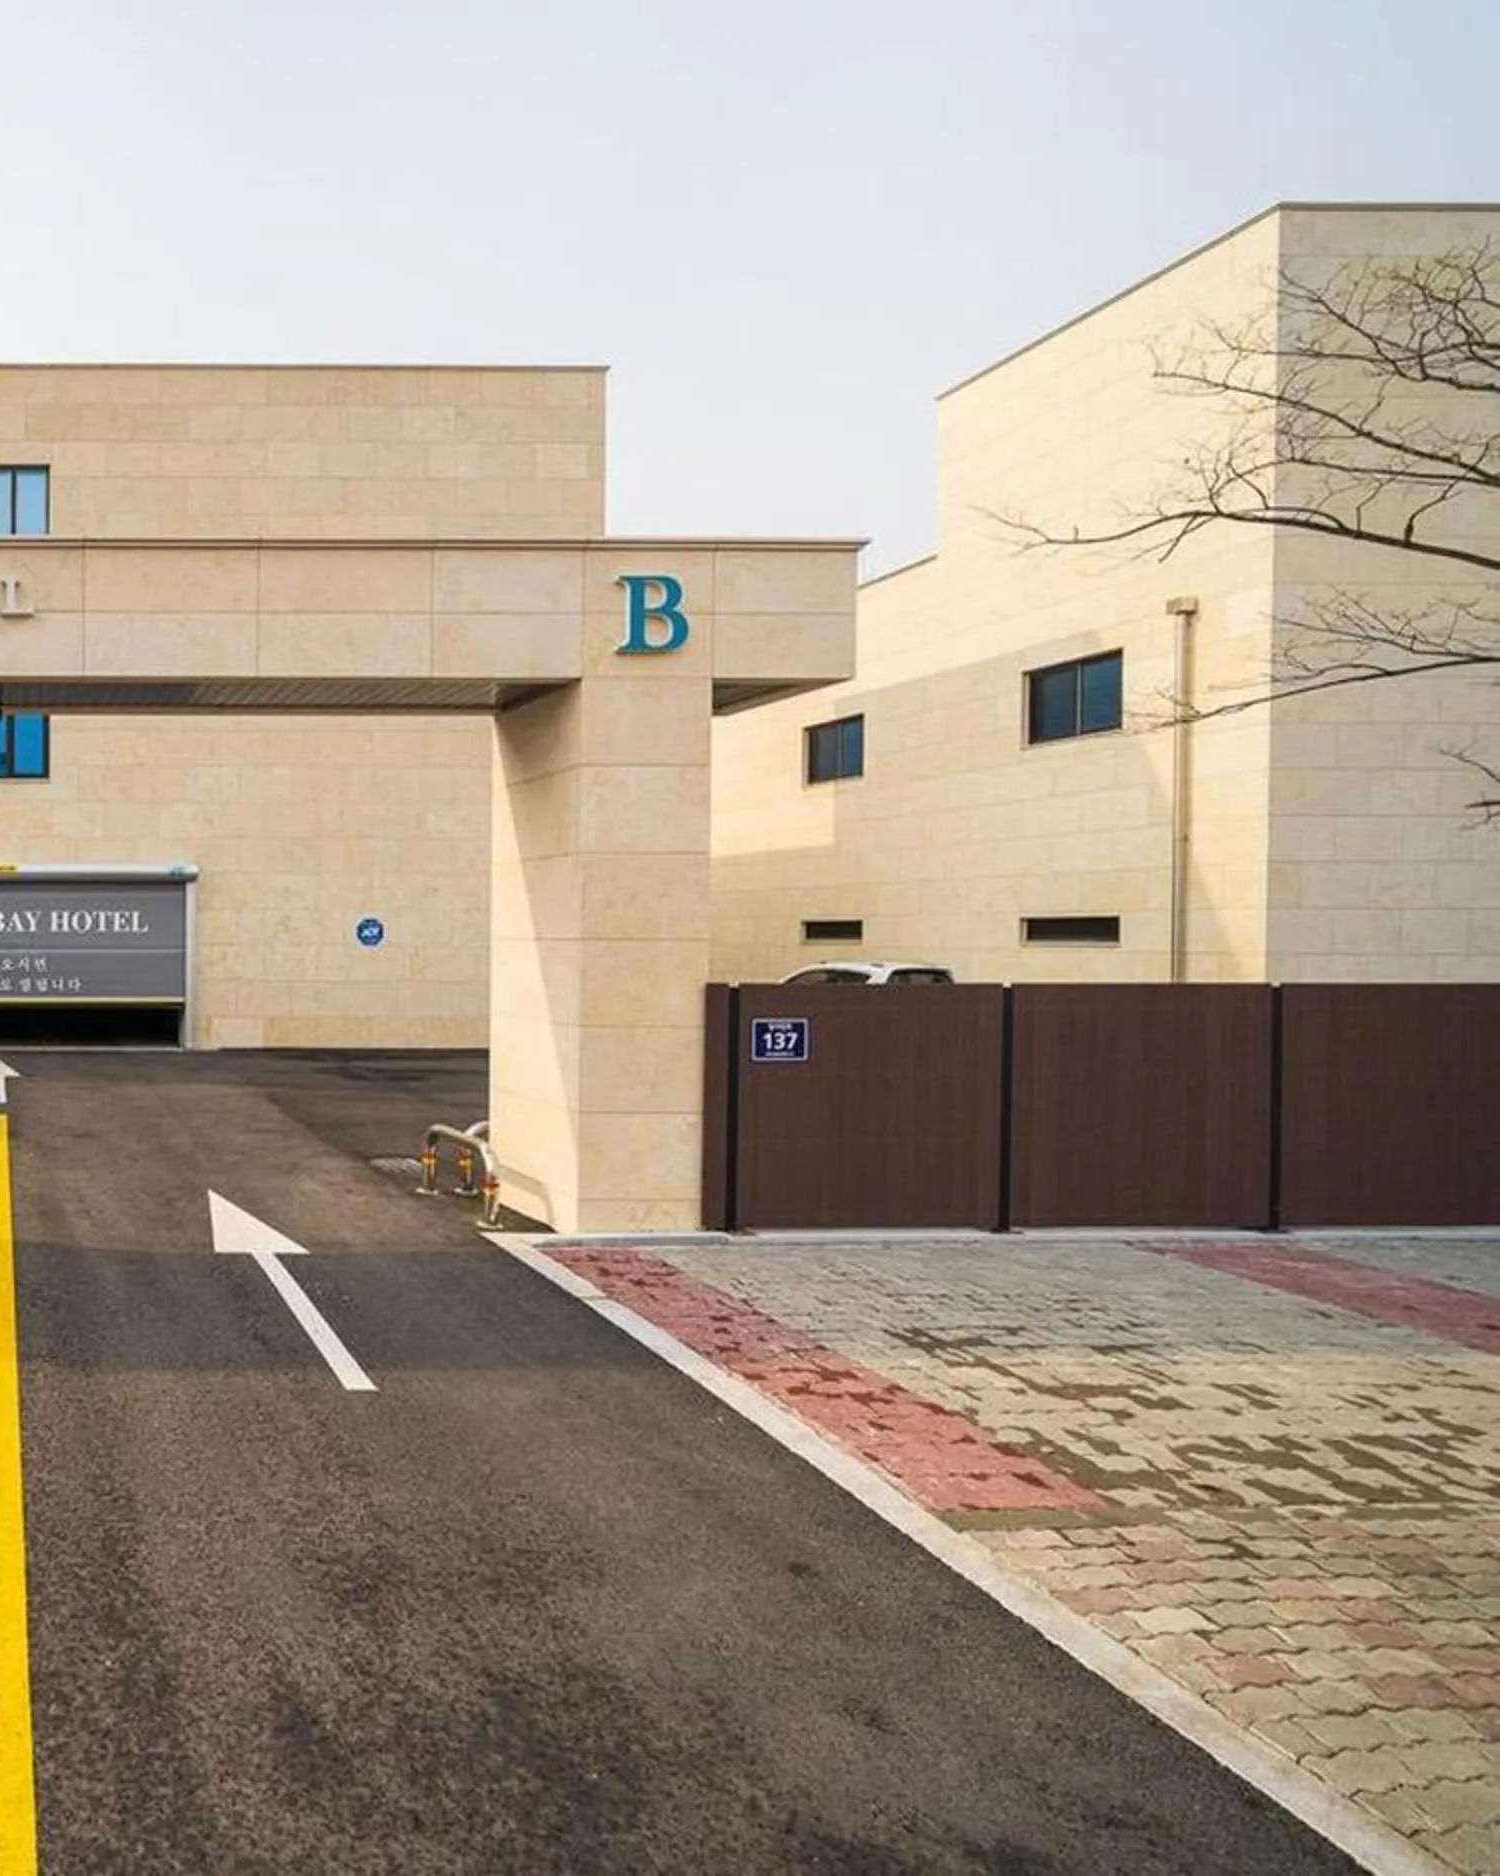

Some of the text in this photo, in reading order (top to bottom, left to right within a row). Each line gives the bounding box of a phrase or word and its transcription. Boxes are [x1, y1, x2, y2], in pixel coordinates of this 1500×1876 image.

[612, 573, 690, 655] B
[50, 910, 148, 933] HOTEL
[763, 1032, 798, 1050] 137
